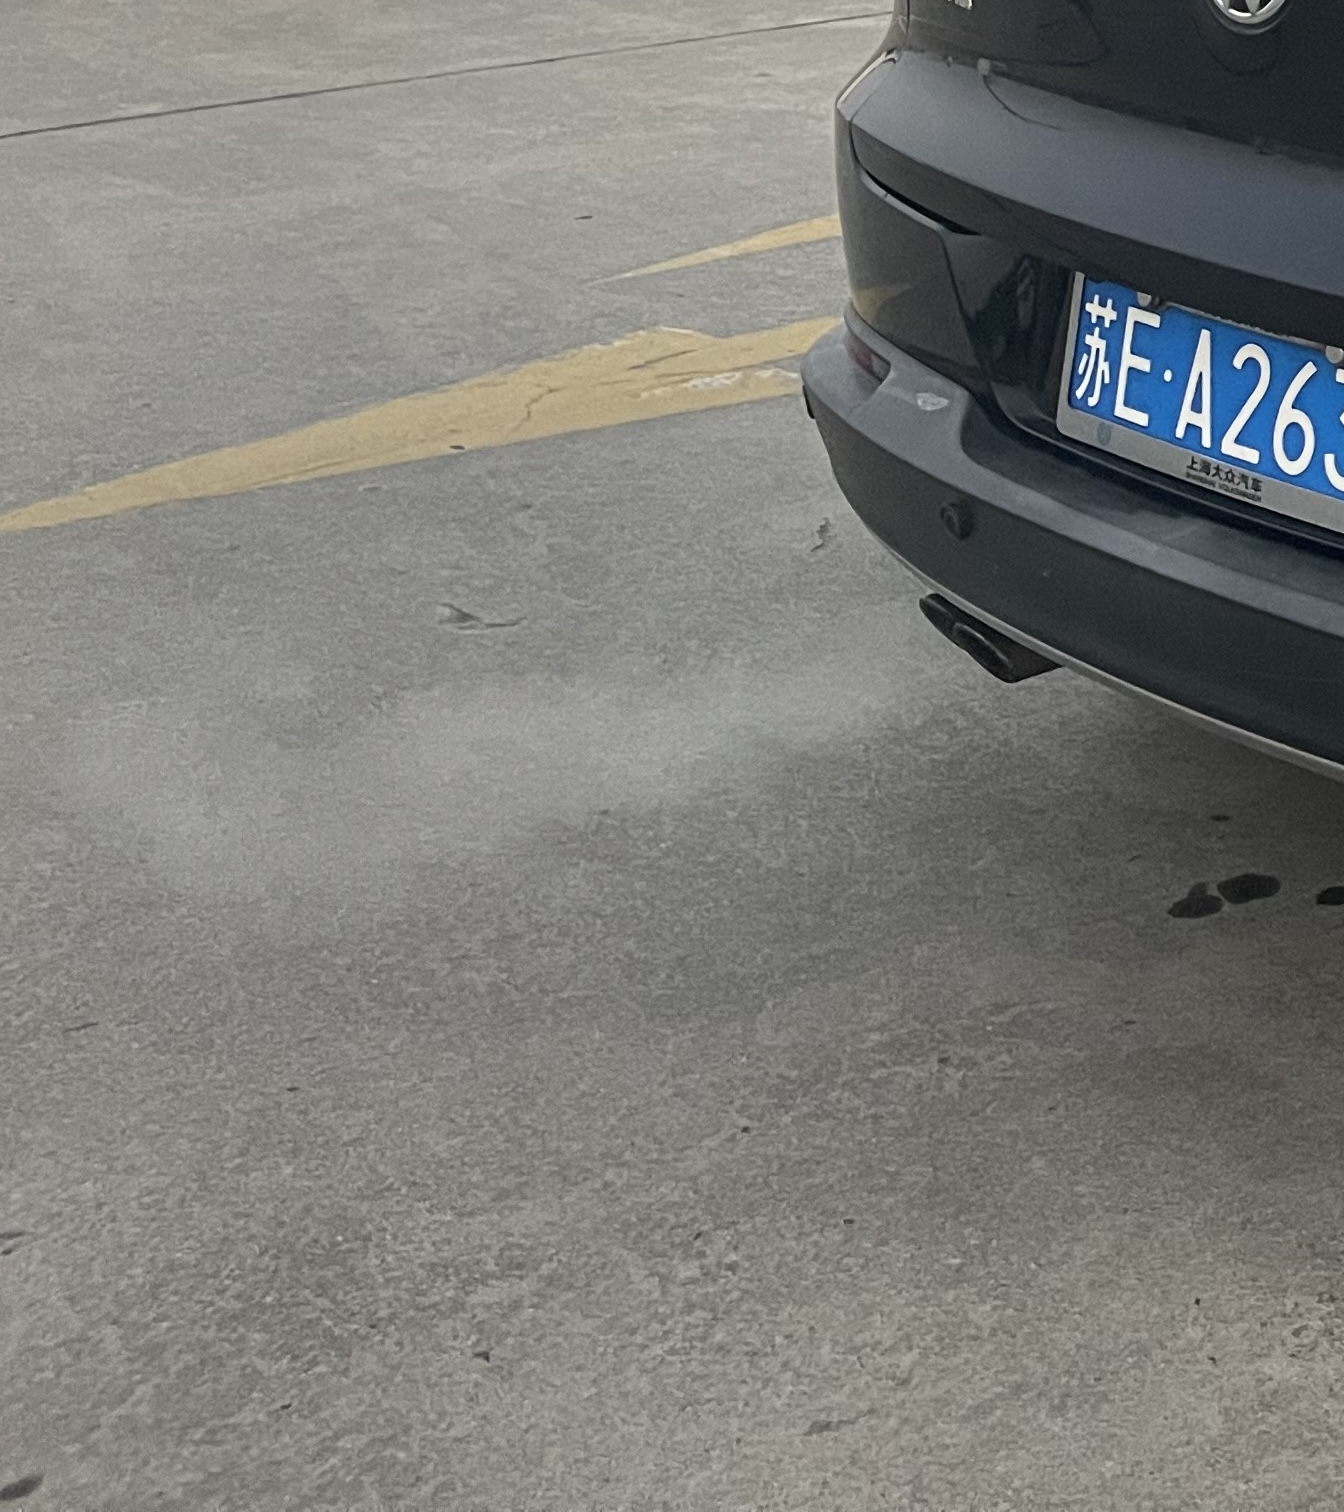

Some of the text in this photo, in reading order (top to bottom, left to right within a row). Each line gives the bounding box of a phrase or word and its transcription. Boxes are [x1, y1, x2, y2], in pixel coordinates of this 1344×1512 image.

[1186, 455, 1263, 492] 上海大众汽车
